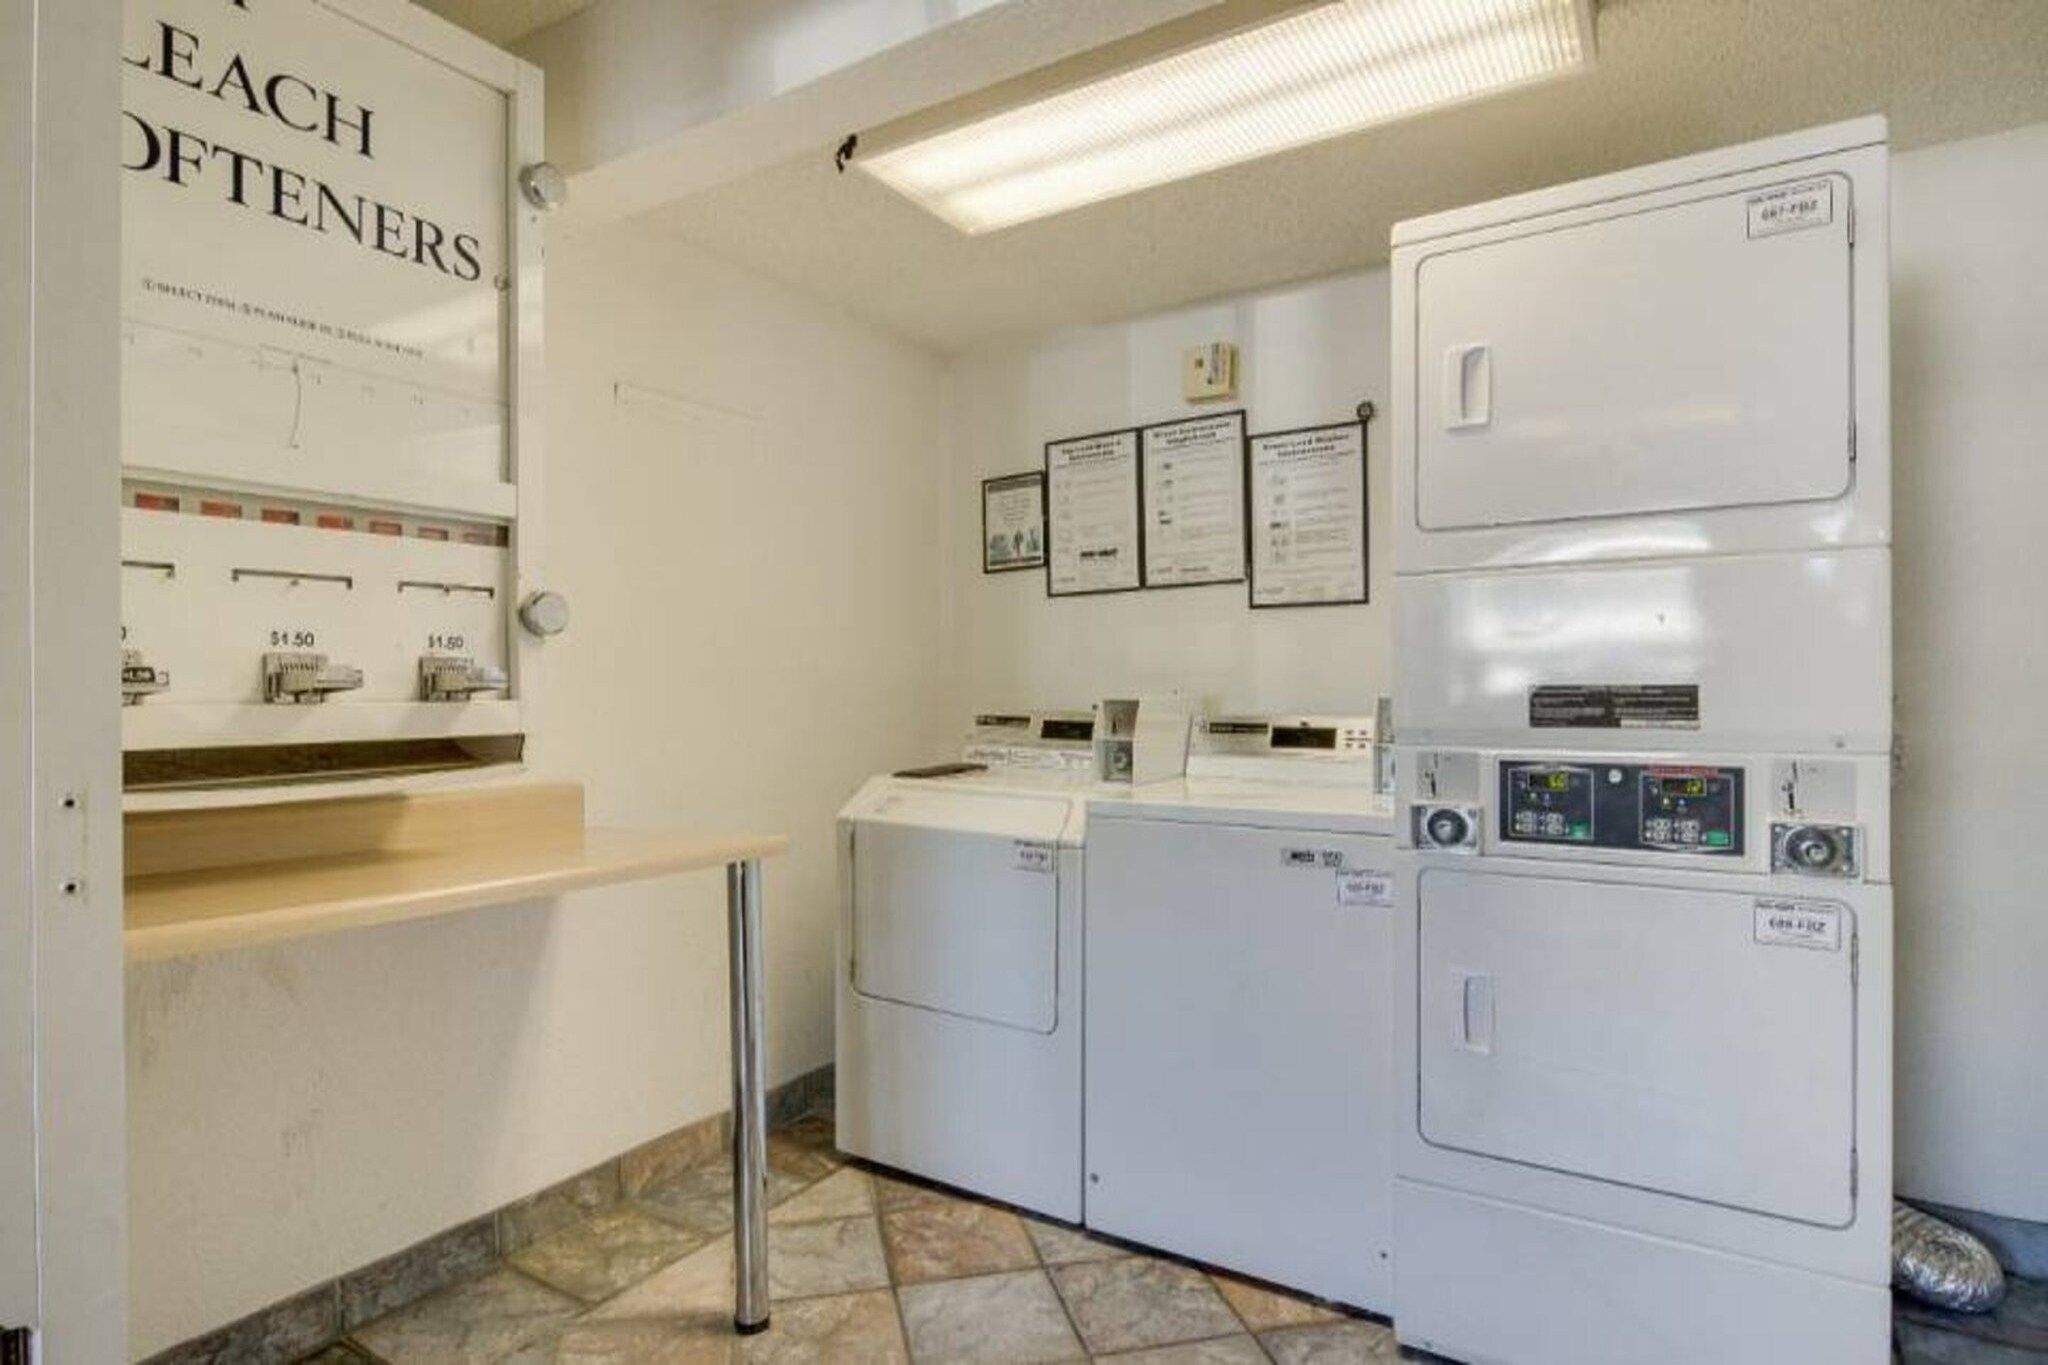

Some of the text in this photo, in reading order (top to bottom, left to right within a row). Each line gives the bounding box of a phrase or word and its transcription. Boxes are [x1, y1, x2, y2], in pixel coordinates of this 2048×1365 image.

[122, 19, 376, 159] EACH
[270, 631, 315, 648] $1.50
[428, 634, 465, 650] $1.50
